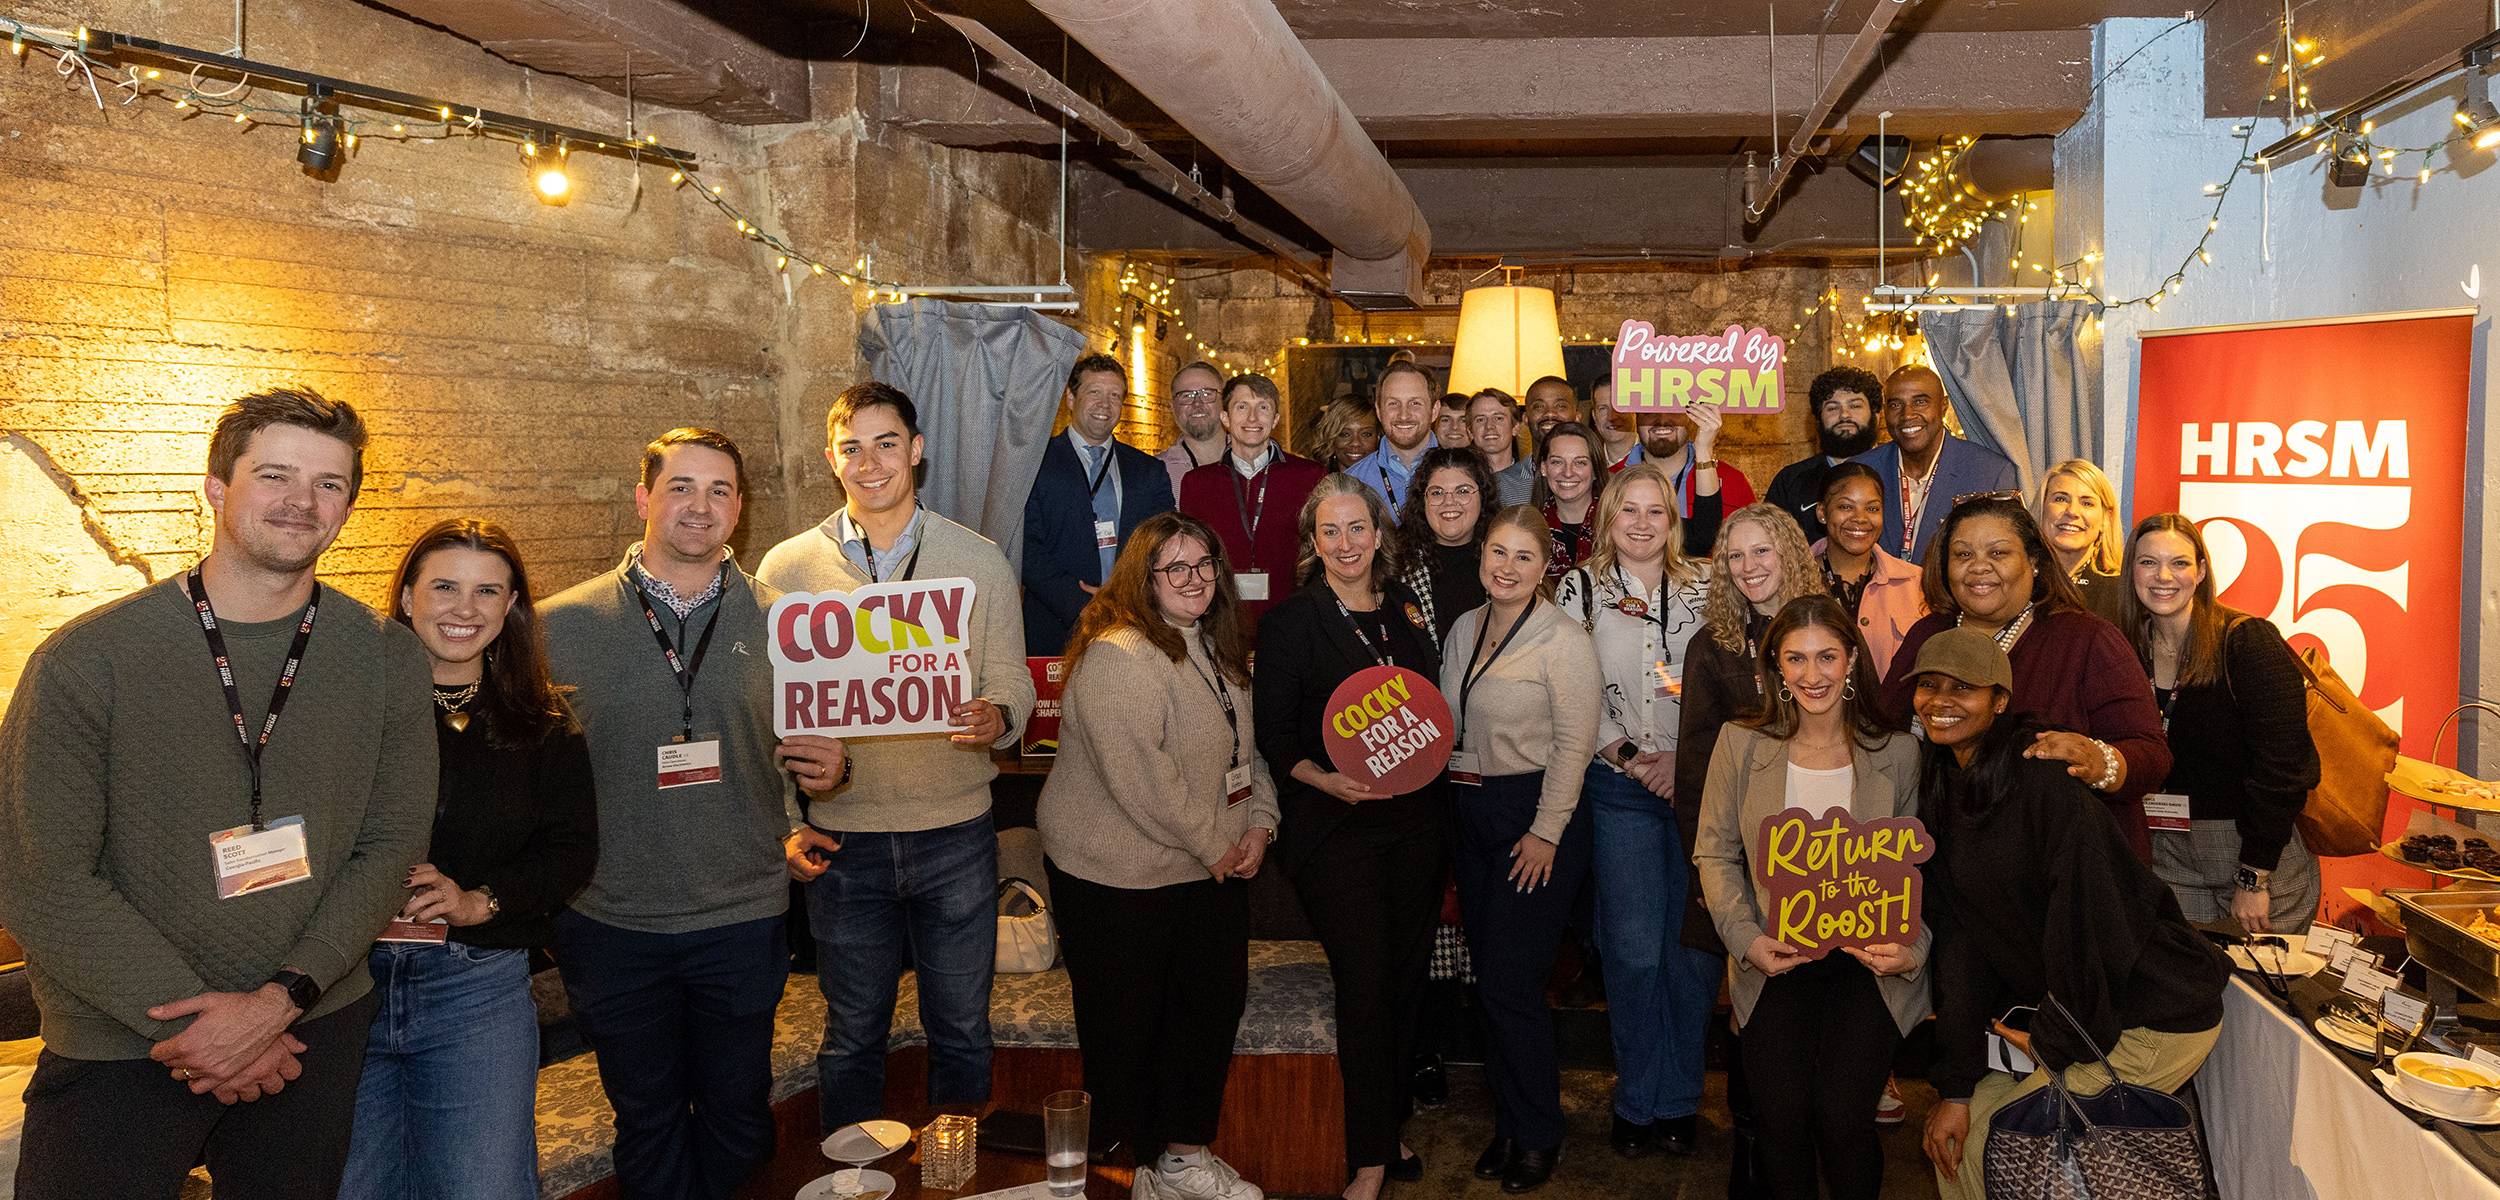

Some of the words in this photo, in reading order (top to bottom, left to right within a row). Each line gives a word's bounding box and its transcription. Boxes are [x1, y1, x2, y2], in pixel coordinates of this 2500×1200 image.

[1744, 334, 1778, 375] by
[1616, 368, 1779, 408] HRSM
[2180, 419, 2410, 479] HRSM
[777, 587, 965, 663] COCKY
[889, 653, 938, 673] FOR
[944, 652, 960, 671] A
[785, 674, 961, 730] REASON
[1332, 673, 1412, 739] COCKY
[1360, 715, 1404, 752] FOR
[1399, 705, 1420, 728] A
[1365, 718, 1442, 779] REASON
[222, 844, 242, 854] REED
[223, 849, 246, 860] SCOTT
[1767, 817, 1924, 879] Return
[1818, 879, 1841, 902] to
[1842, 870, 1881, 898] the
[1777, 877, 1911, 949] Roost!
